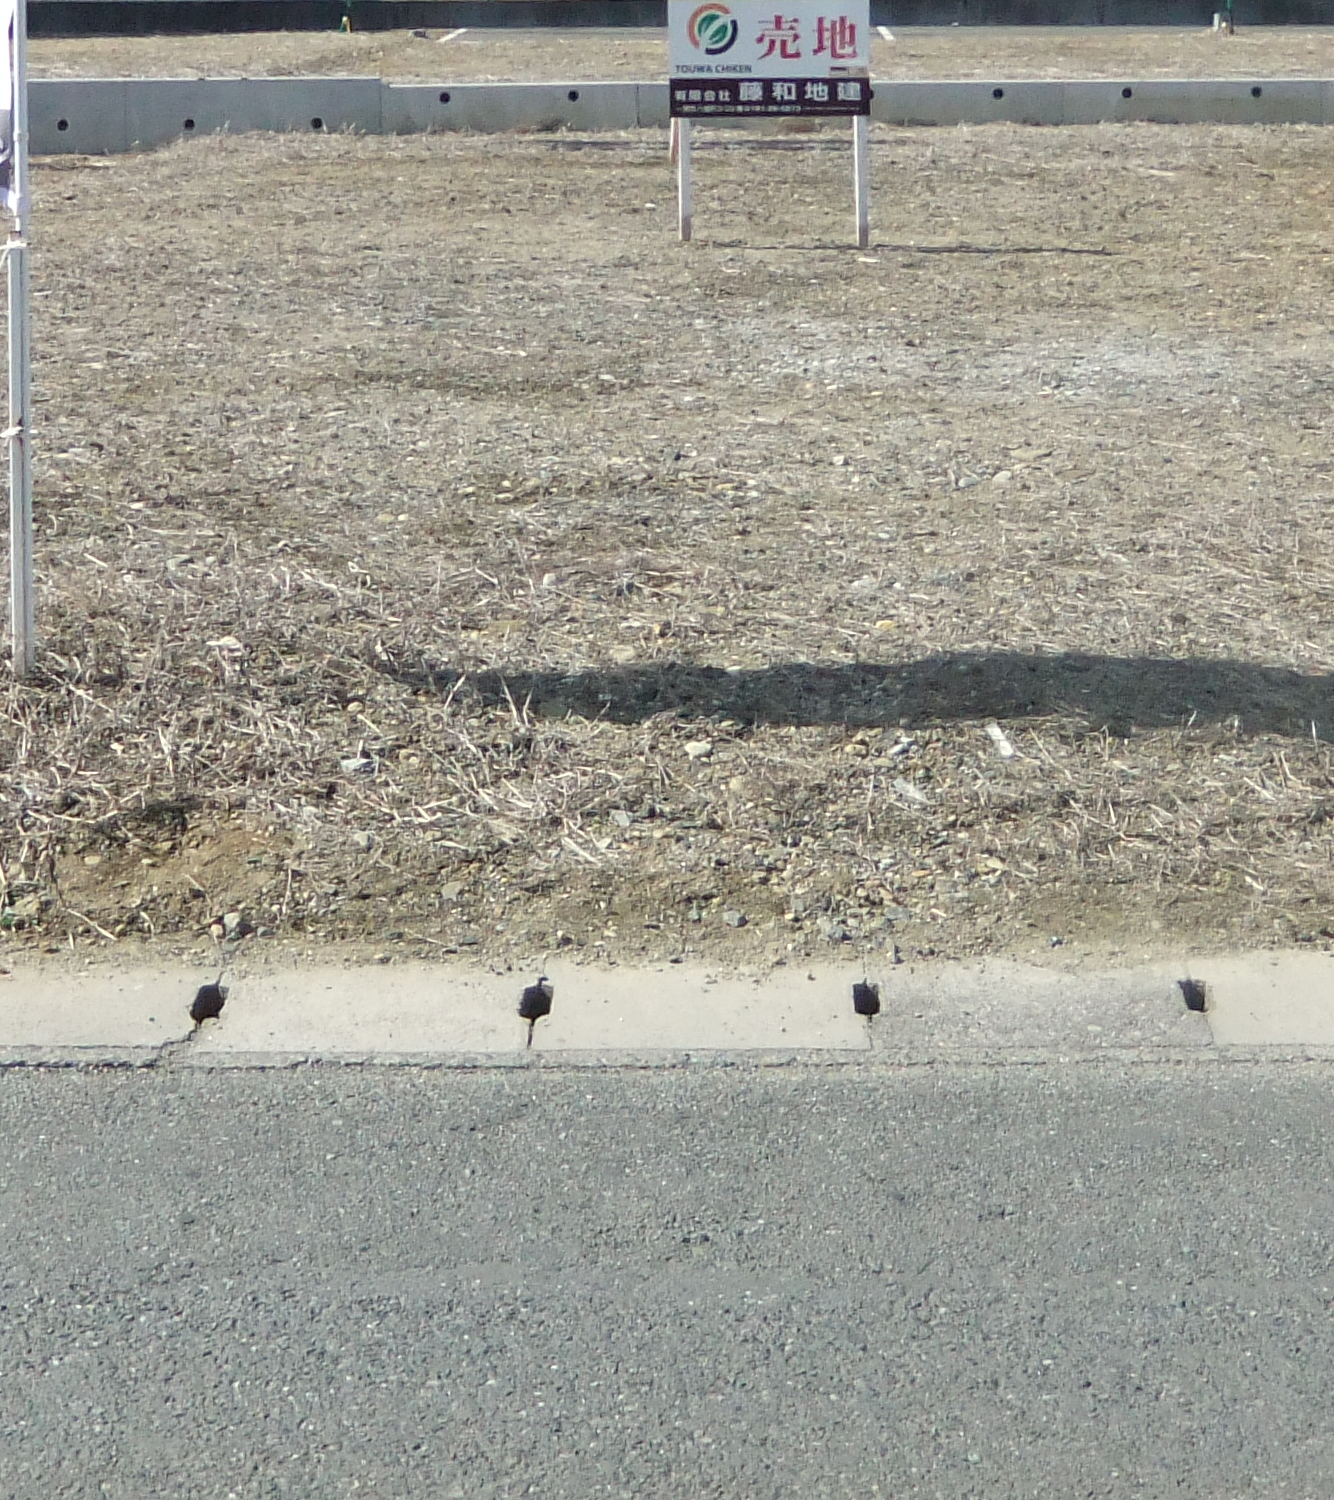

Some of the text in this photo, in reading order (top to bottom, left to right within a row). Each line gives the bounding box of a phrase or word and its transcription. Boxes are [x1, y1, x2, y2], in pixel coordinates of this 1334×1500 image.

[756, 14, 857, 60] 売地
[674, 64, 713, 74] TOUWA
[675, 90, 731, 102] 有限会社
